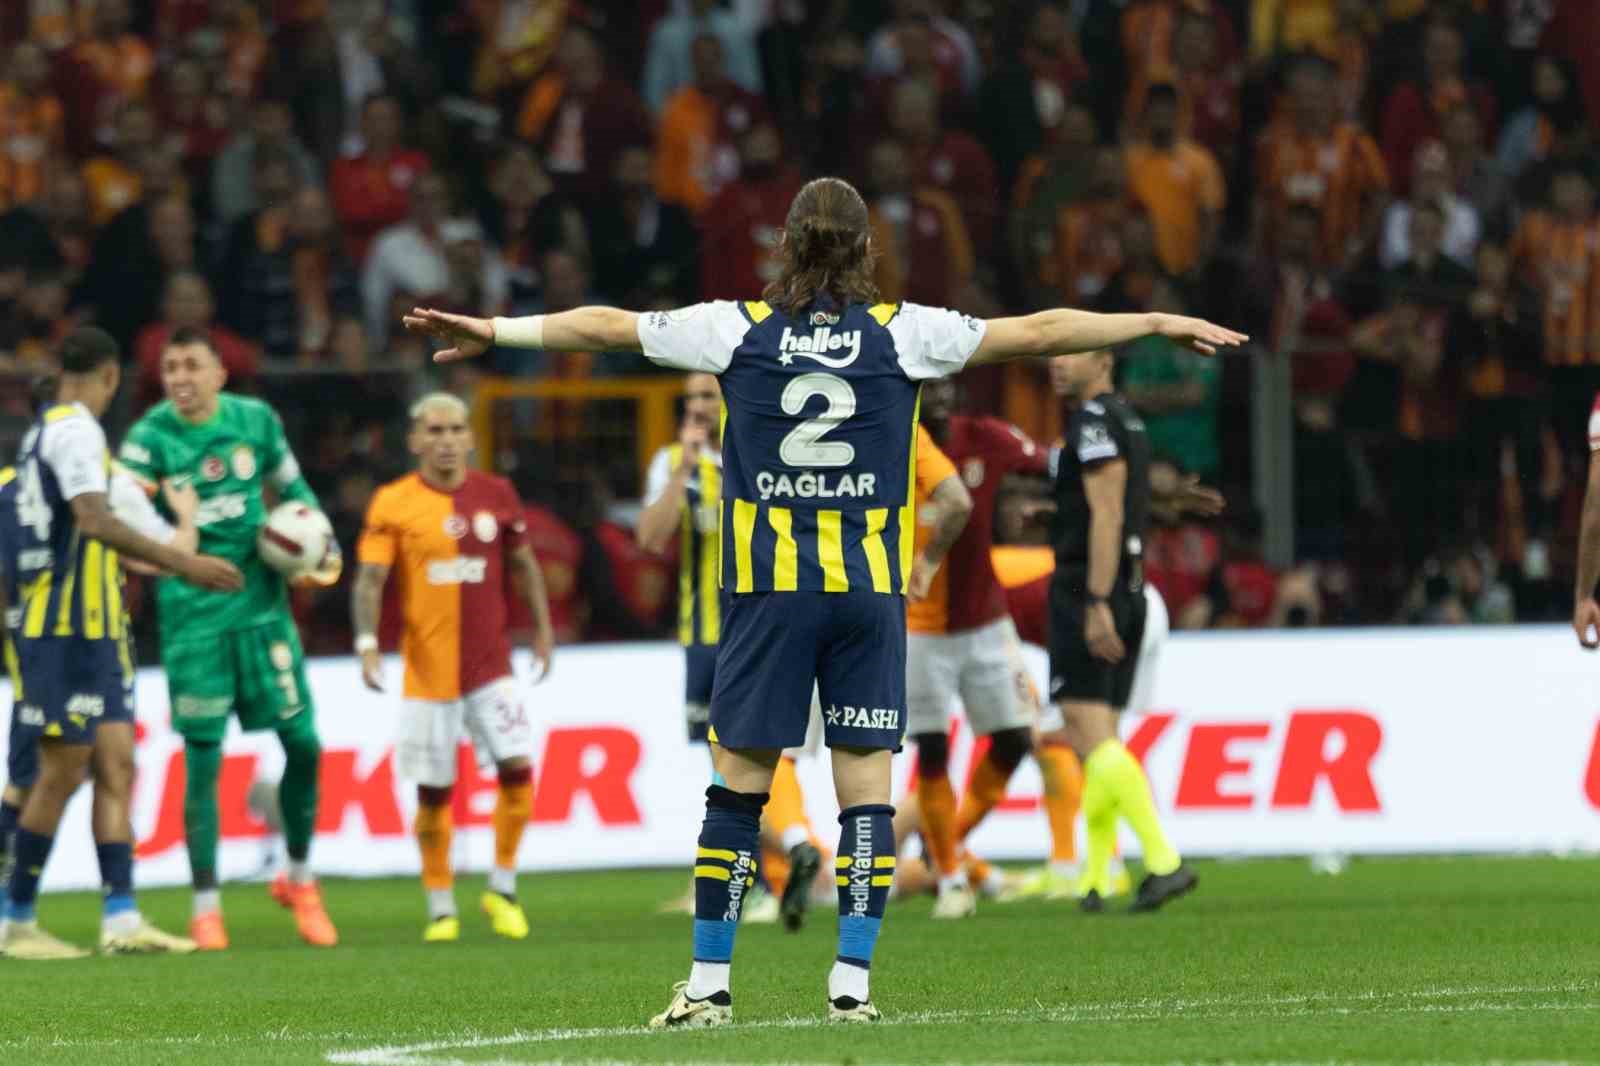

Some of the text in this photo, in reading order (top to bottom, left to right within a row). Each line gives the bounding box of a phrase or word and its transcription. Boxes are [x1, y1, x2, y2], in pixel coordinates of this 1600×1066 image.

[779, 327, 861, 368] halley
[779, 372, 856, 466] 2
[756, 471, 876, 500] ÇAĞLAR
